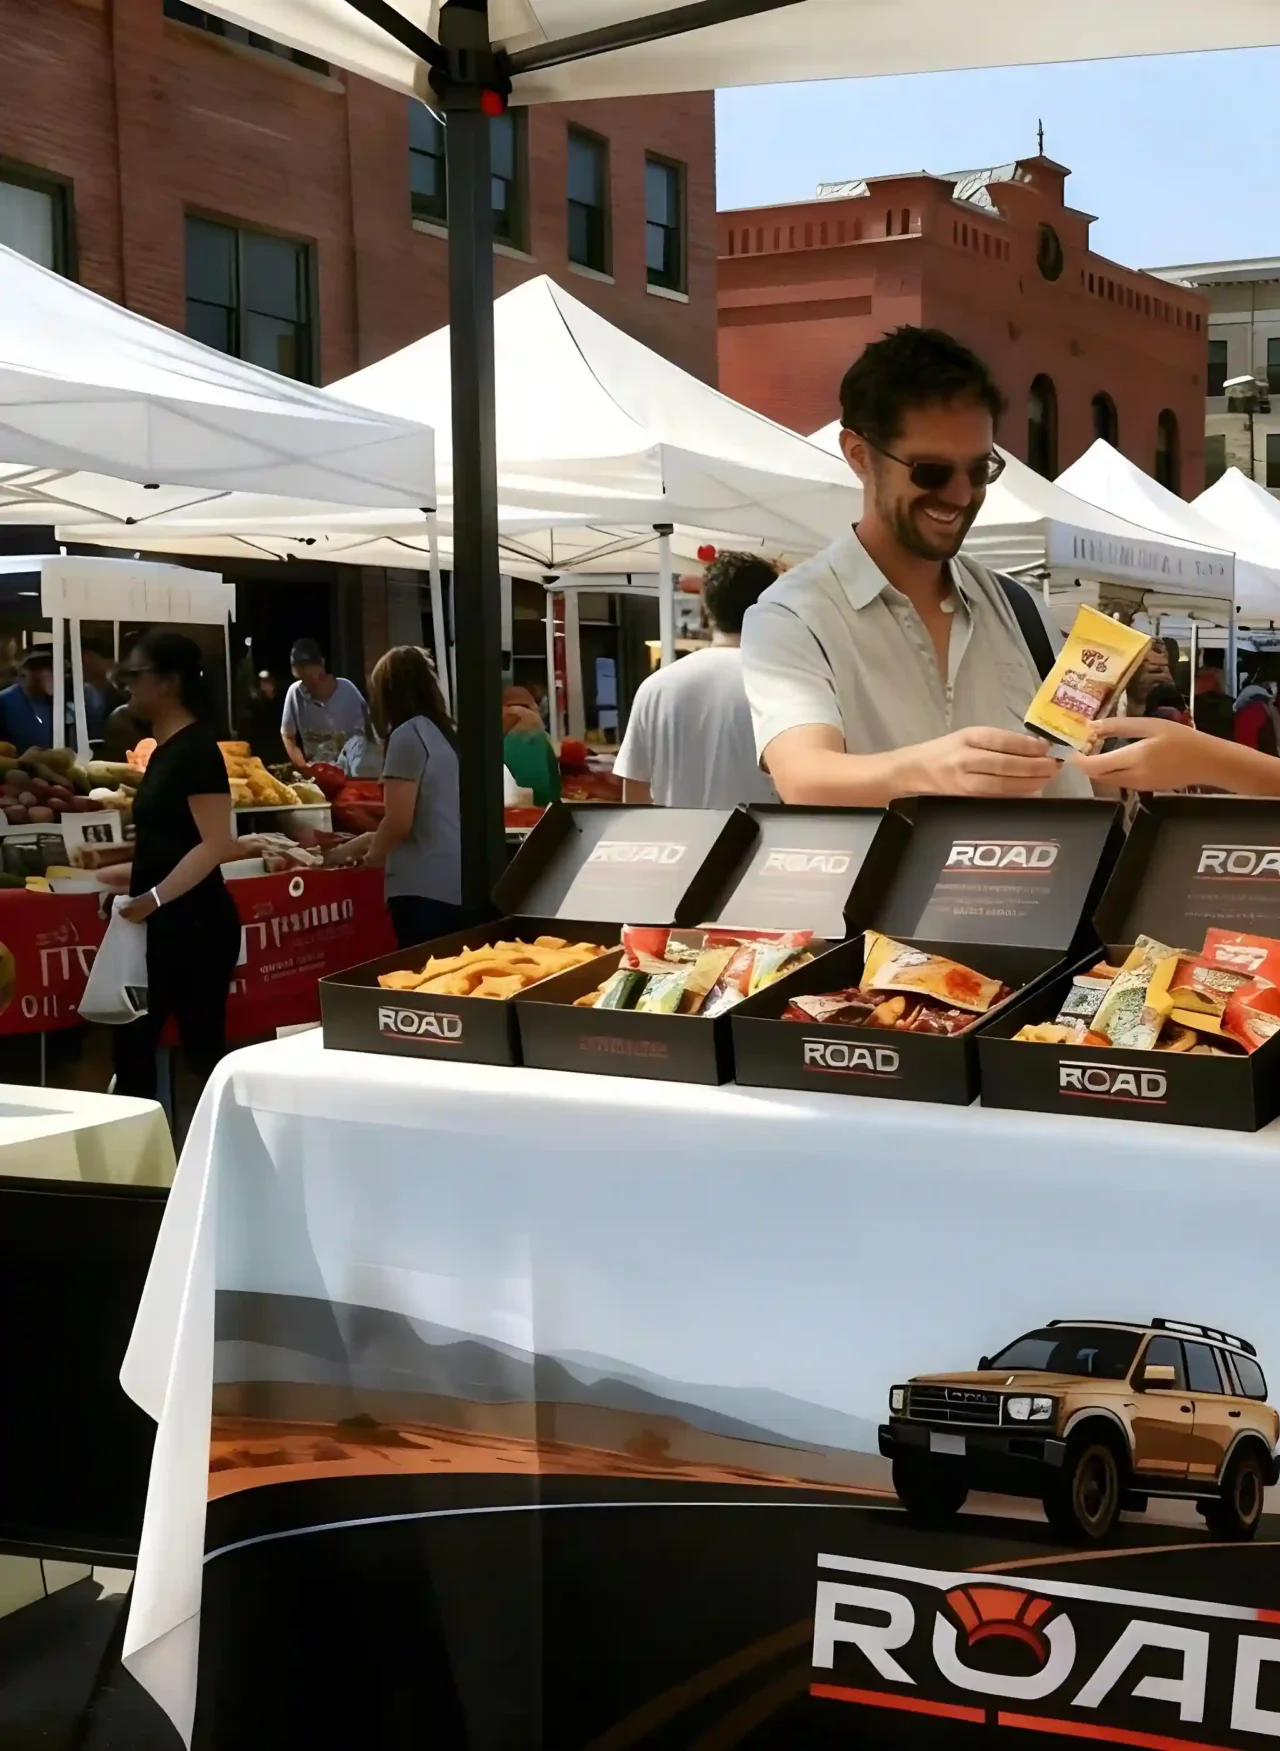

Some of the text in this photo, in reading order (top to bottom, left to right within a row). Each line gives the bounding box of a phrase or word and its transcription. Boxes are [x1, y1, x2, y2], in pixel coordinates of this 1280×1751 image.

[589, 844, 686, 864] ROAD
[763, 853, 850, 874] ROAD
[945, 845, 1058, 868] ROAD
[378, 1009, 462, 1037] ROAD
[804, 1043, 899, 1071] ROAD
[1059, 1067, 1166, 1097] ROAD
